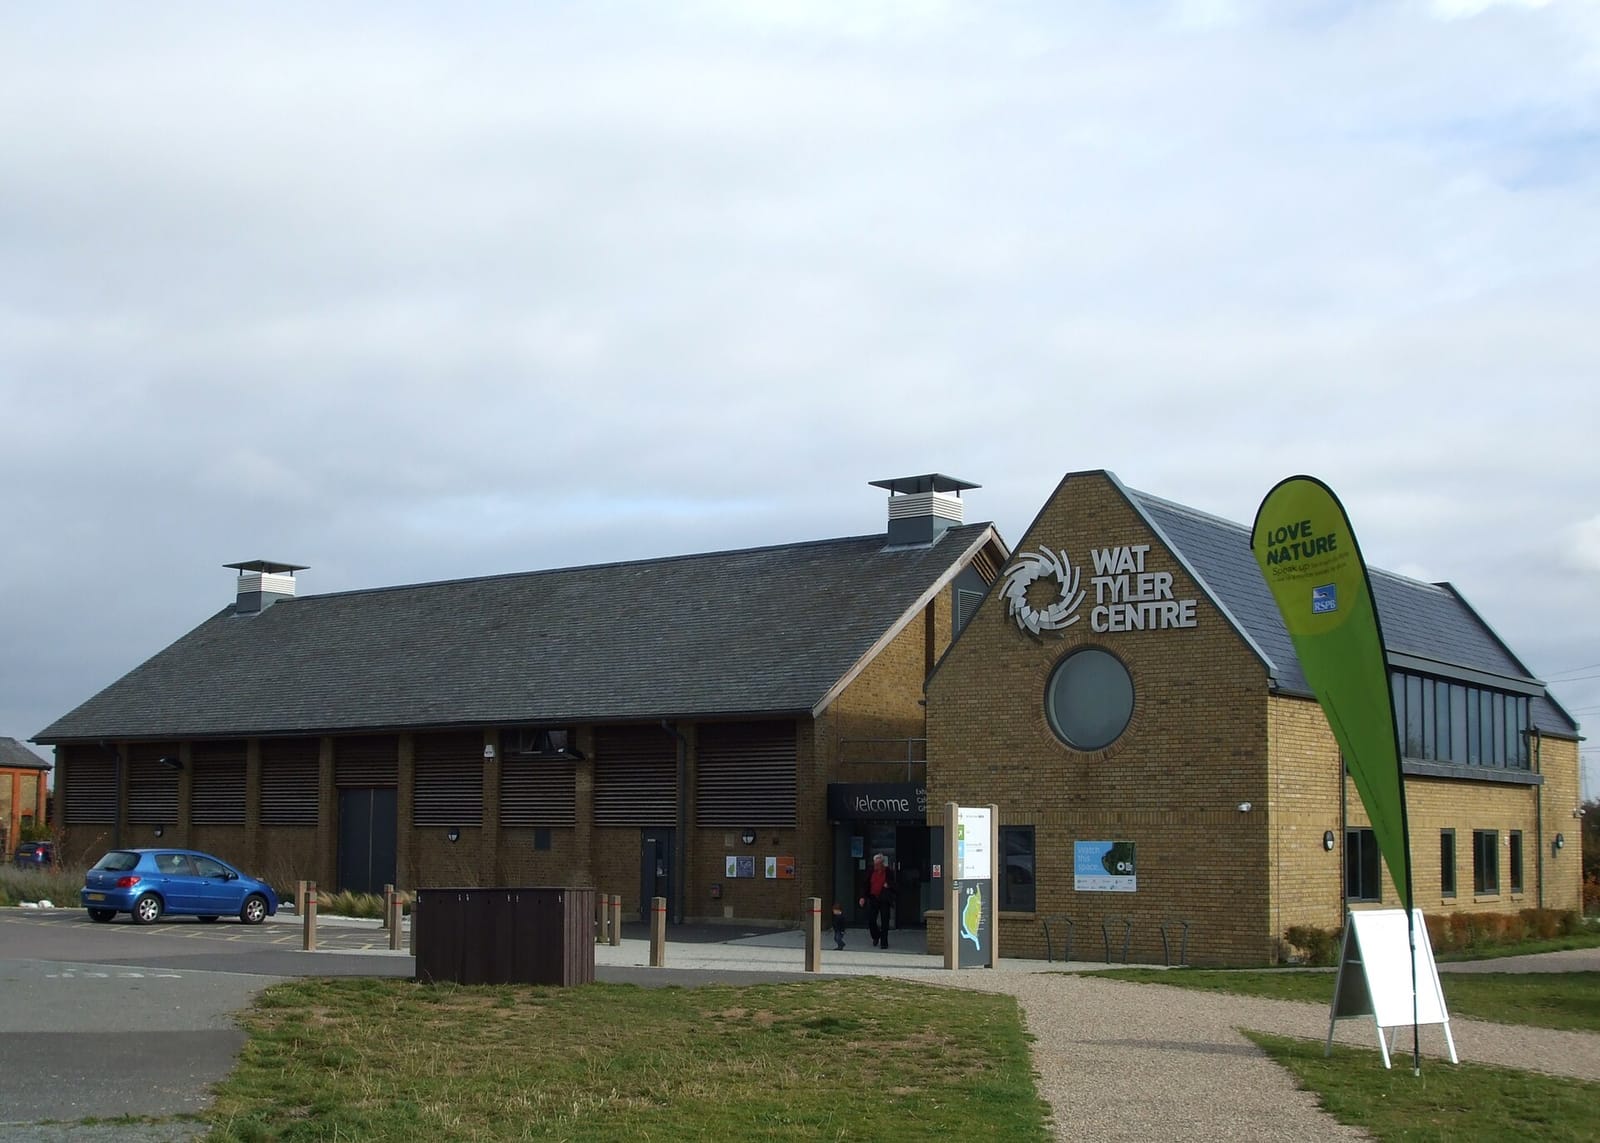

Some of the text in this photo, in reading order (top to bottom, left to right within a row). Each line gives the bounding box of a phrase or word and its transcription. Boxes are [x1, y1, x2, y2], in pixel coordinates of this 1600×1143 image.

[1266, 533, 1338, 566] NATURE
[1267, 520, 1313, 547] LOVE
[1090, 544, 1150, 576] WAT
[1272, 566, 1298, 576] Speak
[1298, 563, 1310, 572] up
[1090, 571, 1174, 604] TYLER
[1090, 599, 1197, 633] CENTRE
[1313, 599, 1337, 612] RSPB
